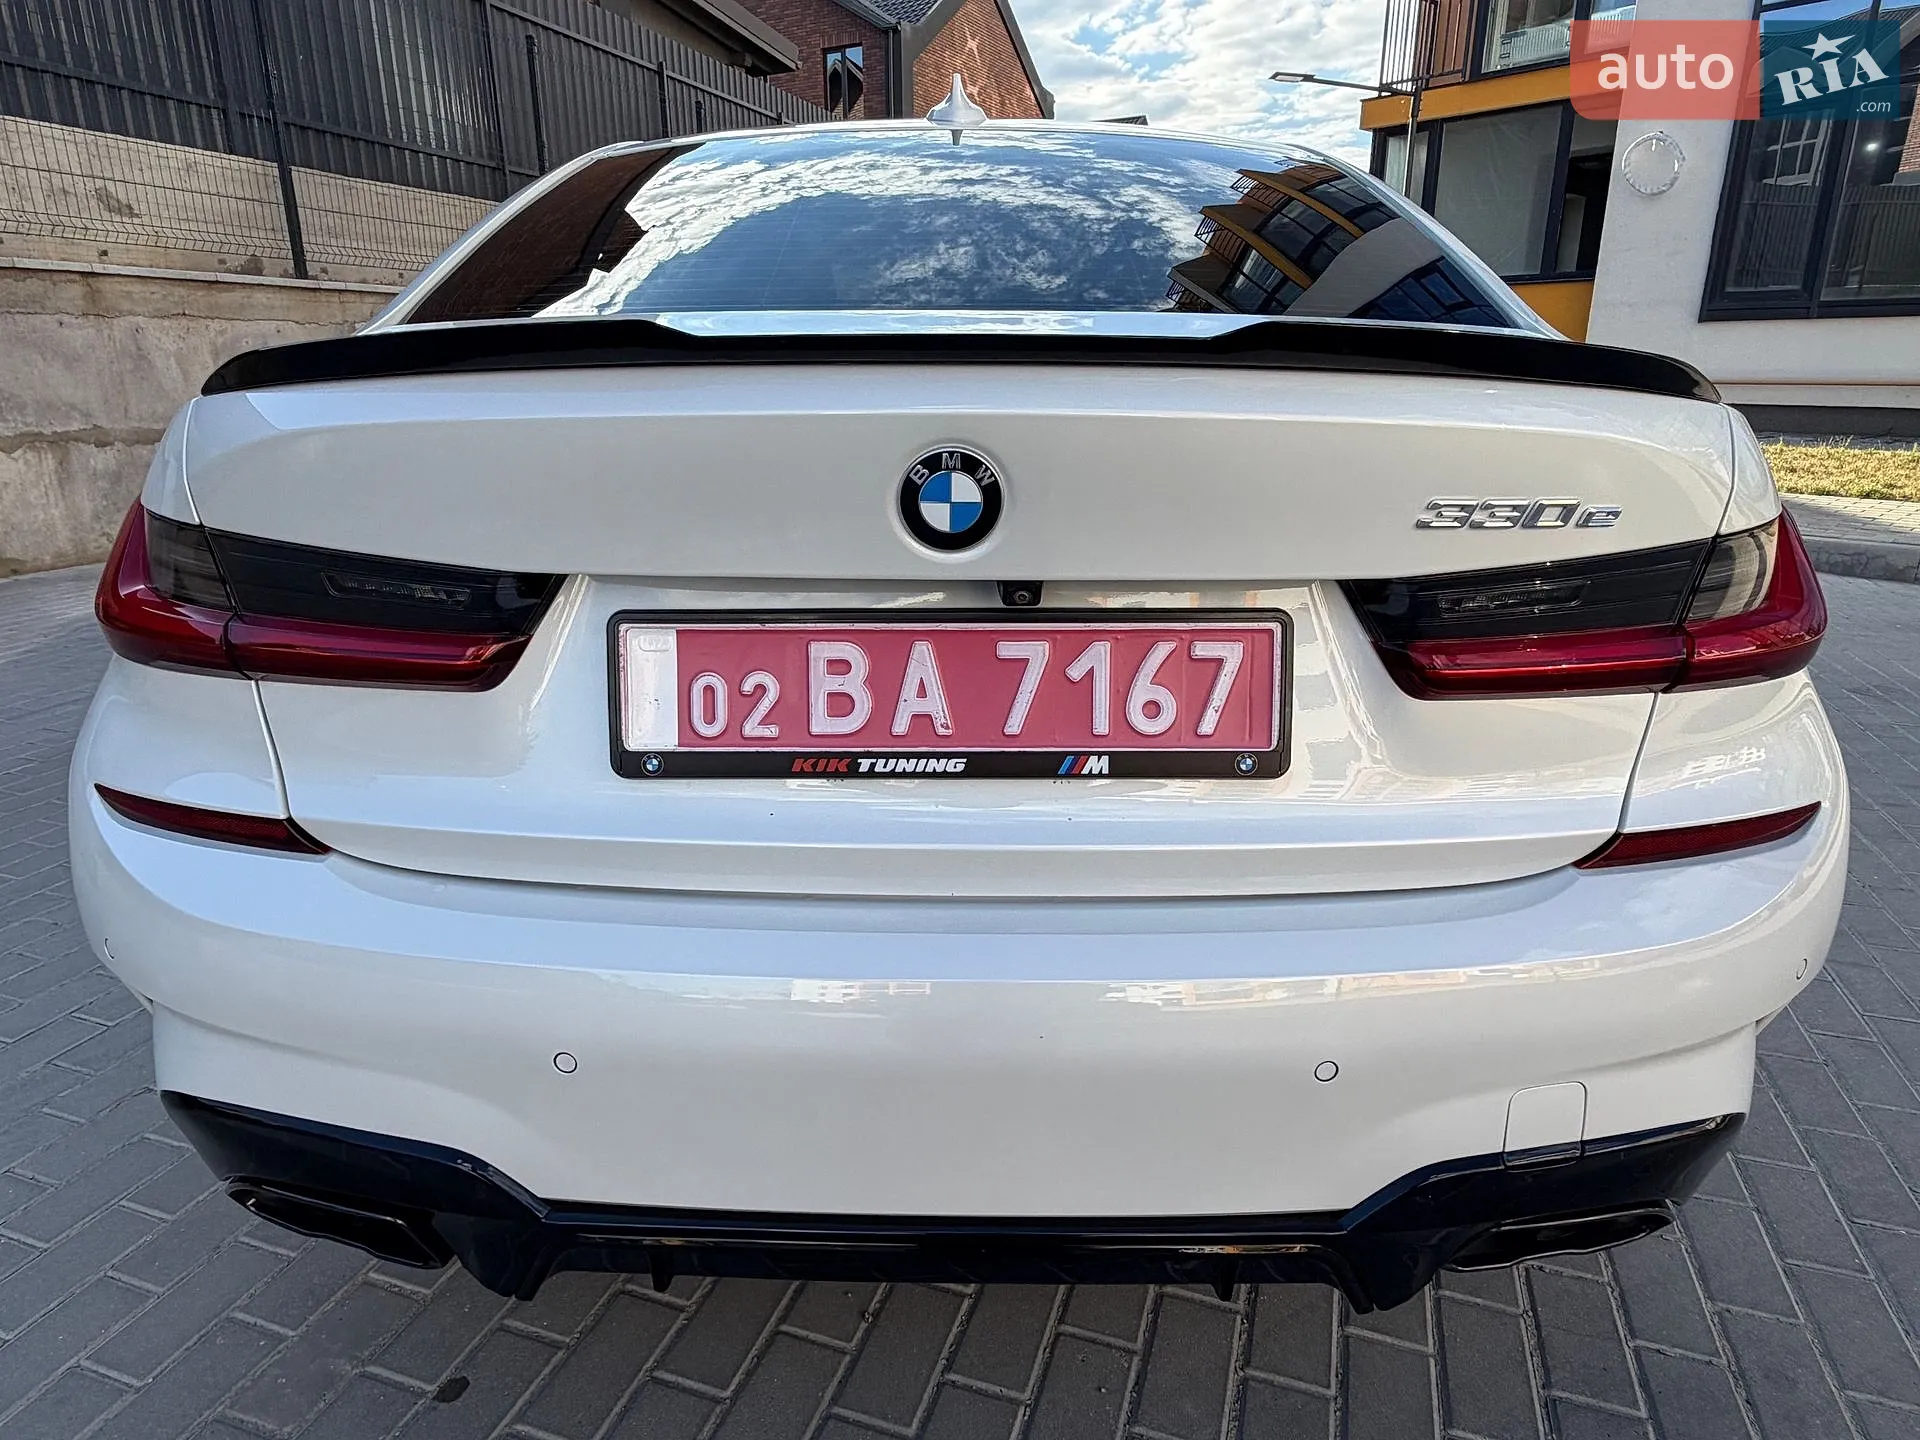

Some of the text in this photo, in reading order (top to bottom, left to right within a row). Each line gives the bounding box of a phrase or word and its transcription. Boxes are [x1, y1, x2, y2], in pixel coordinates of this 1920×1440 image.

[908, 452, 996, 487] BMW
[1415, 496, 1623, 529] 330e
[689, 640, 1245, 739] 02 BA 7167
[791, 758, 967, 773] KIK TUNING
